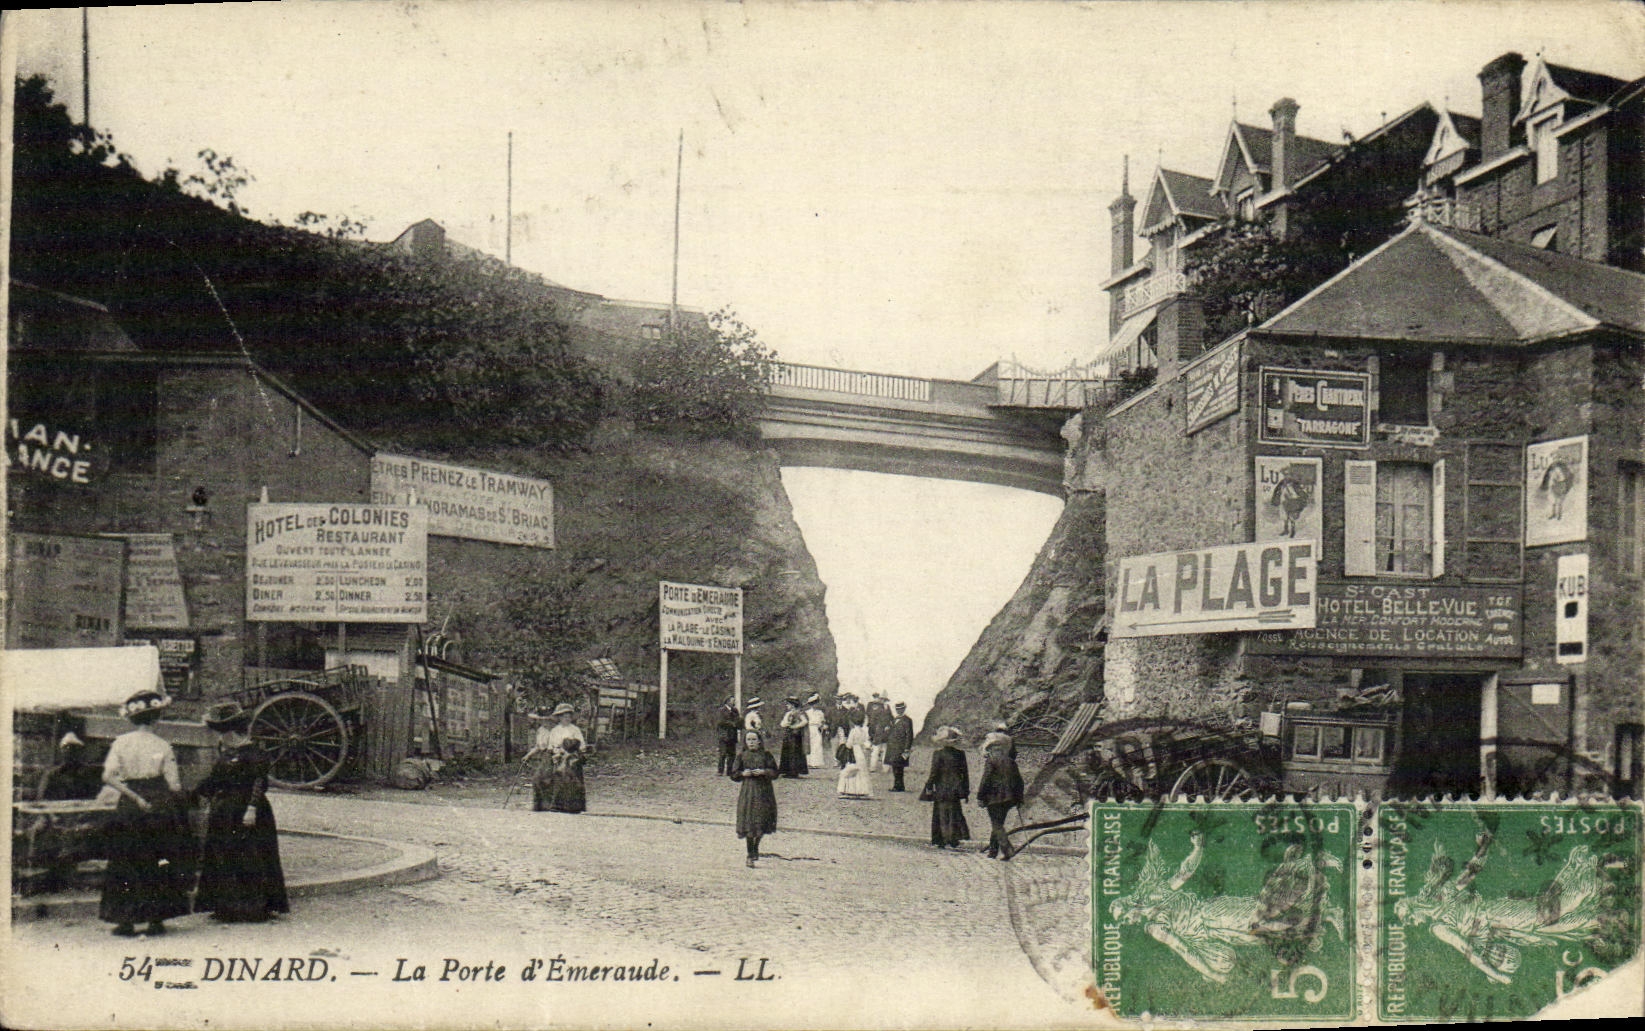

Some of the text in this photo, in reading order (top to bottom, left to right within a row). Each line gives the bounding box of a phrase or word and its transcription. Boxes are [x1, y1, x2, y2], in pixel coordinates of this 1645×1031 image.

[411, 460, 463, 488] PRENEZ
[479, 471, 547, 501] TRAMWAY
[255, 513, 305, 544] HOTEL
[328, 505, 410, 530] COLONIES
[512, 508, 549, 530] BRIAC
[316, 528, 406, 545] RESTAURANT
[276, 544, 314, 556] OUVERT
[1120, 544, 1311, 613] LA PLAGE
[1558, 575, 1586, 598] KUB
[338, 590, 372, 602] DINNER
[663, 584, 690, 602] PORTE
[1371, 586, 1430, 599] CAST
[1317, 598, 1375, 614] HOTEL
[1294, 628, 1360, 642] AGENCE
[1369, 628, 1392, 641] DE
[1402, 627, 1480, 643] LOCATION
[1255, 815, 1340, 834] POSTES
[1540, 815, 1625, 835] POSTES
